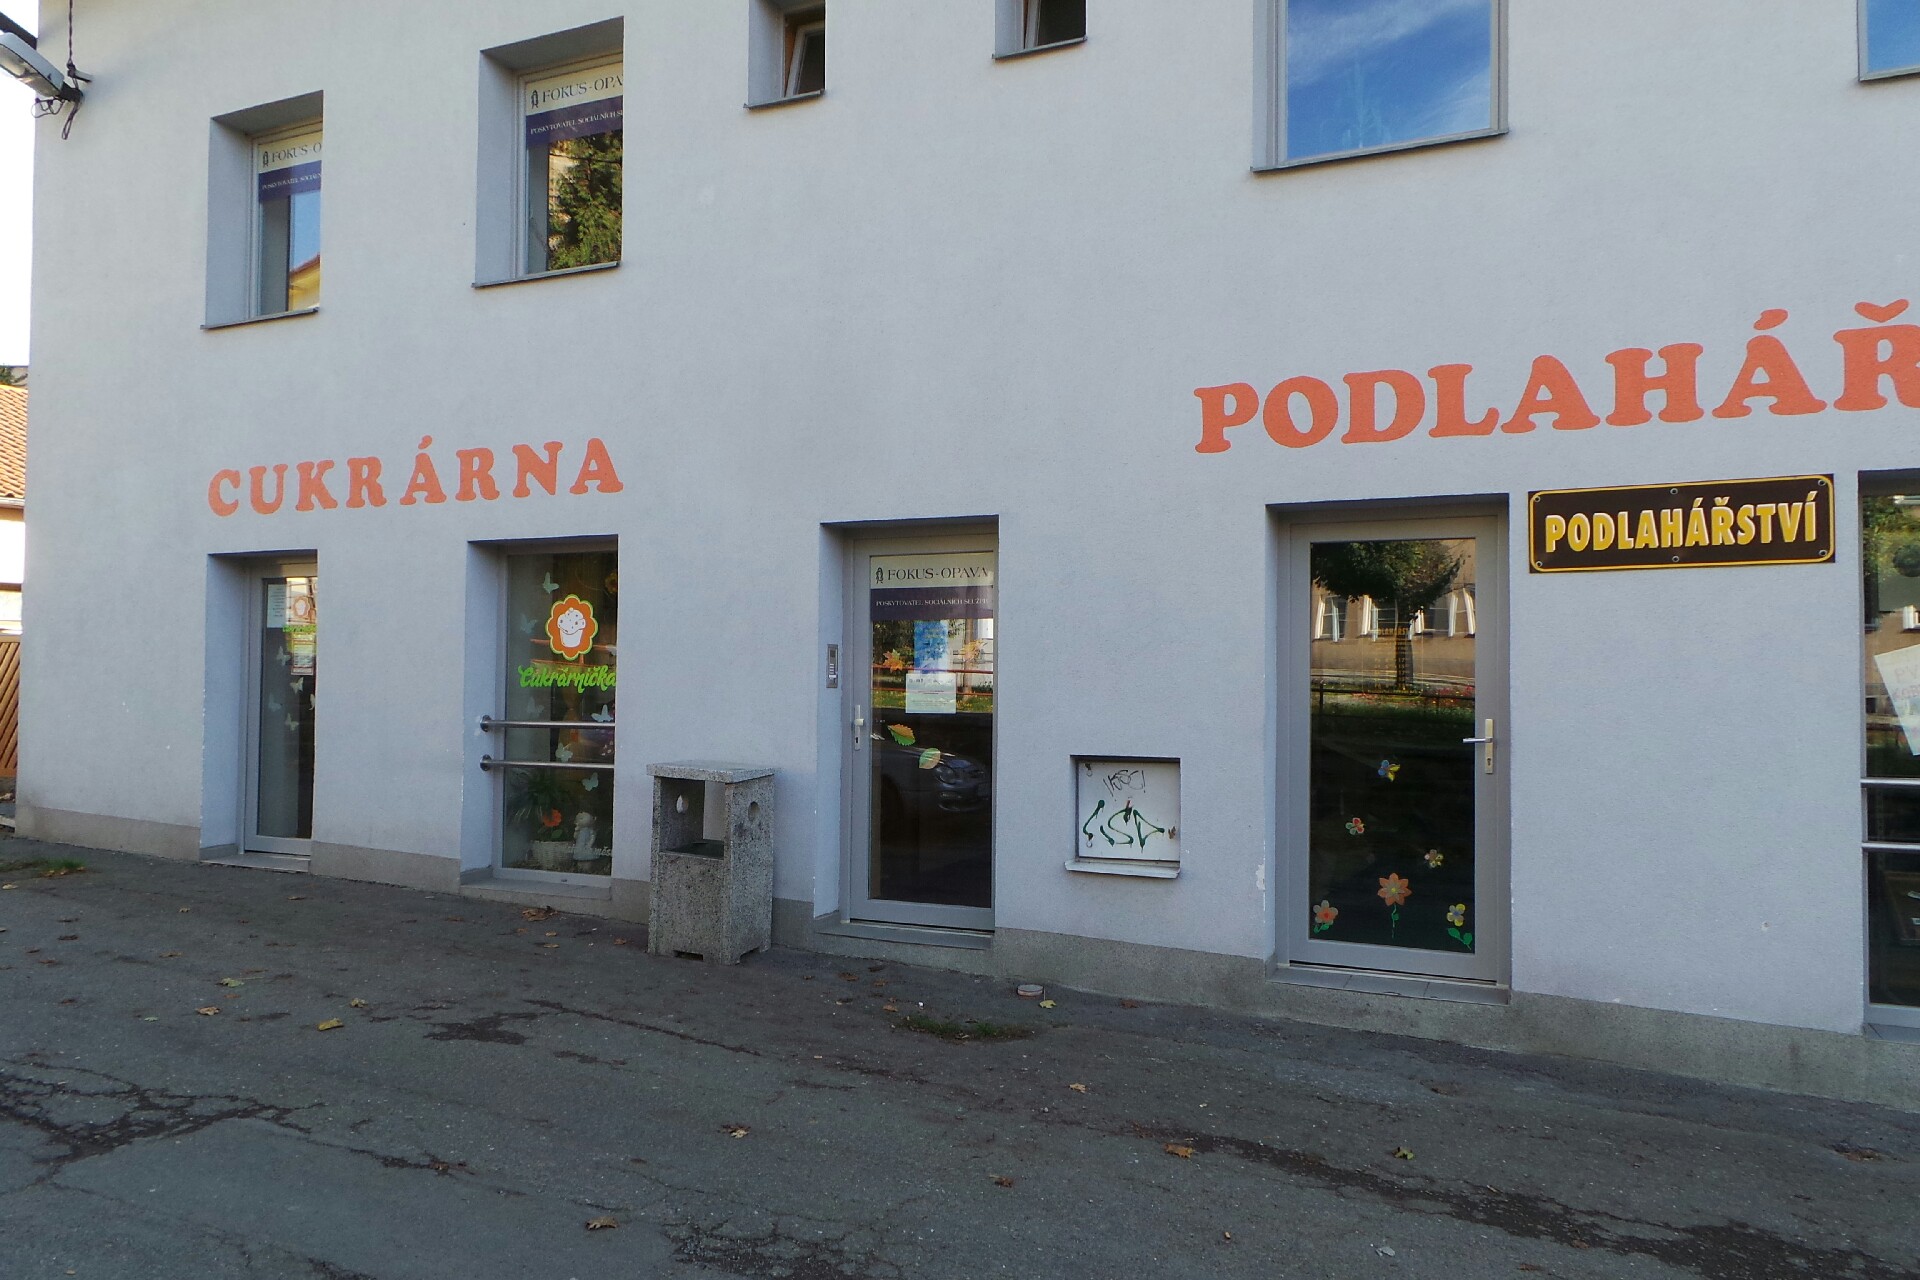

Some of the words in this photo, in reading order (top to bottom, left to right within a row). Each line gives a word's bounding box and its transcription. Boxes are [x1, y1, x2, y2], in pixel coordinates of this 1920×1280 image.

[208, 434, 624, 517] CUKRÁRNA
[1545, 491, 1818, 554] PODLAHÁŘSTVÍ
[518, 665, 616, 694] Cukrárnička
